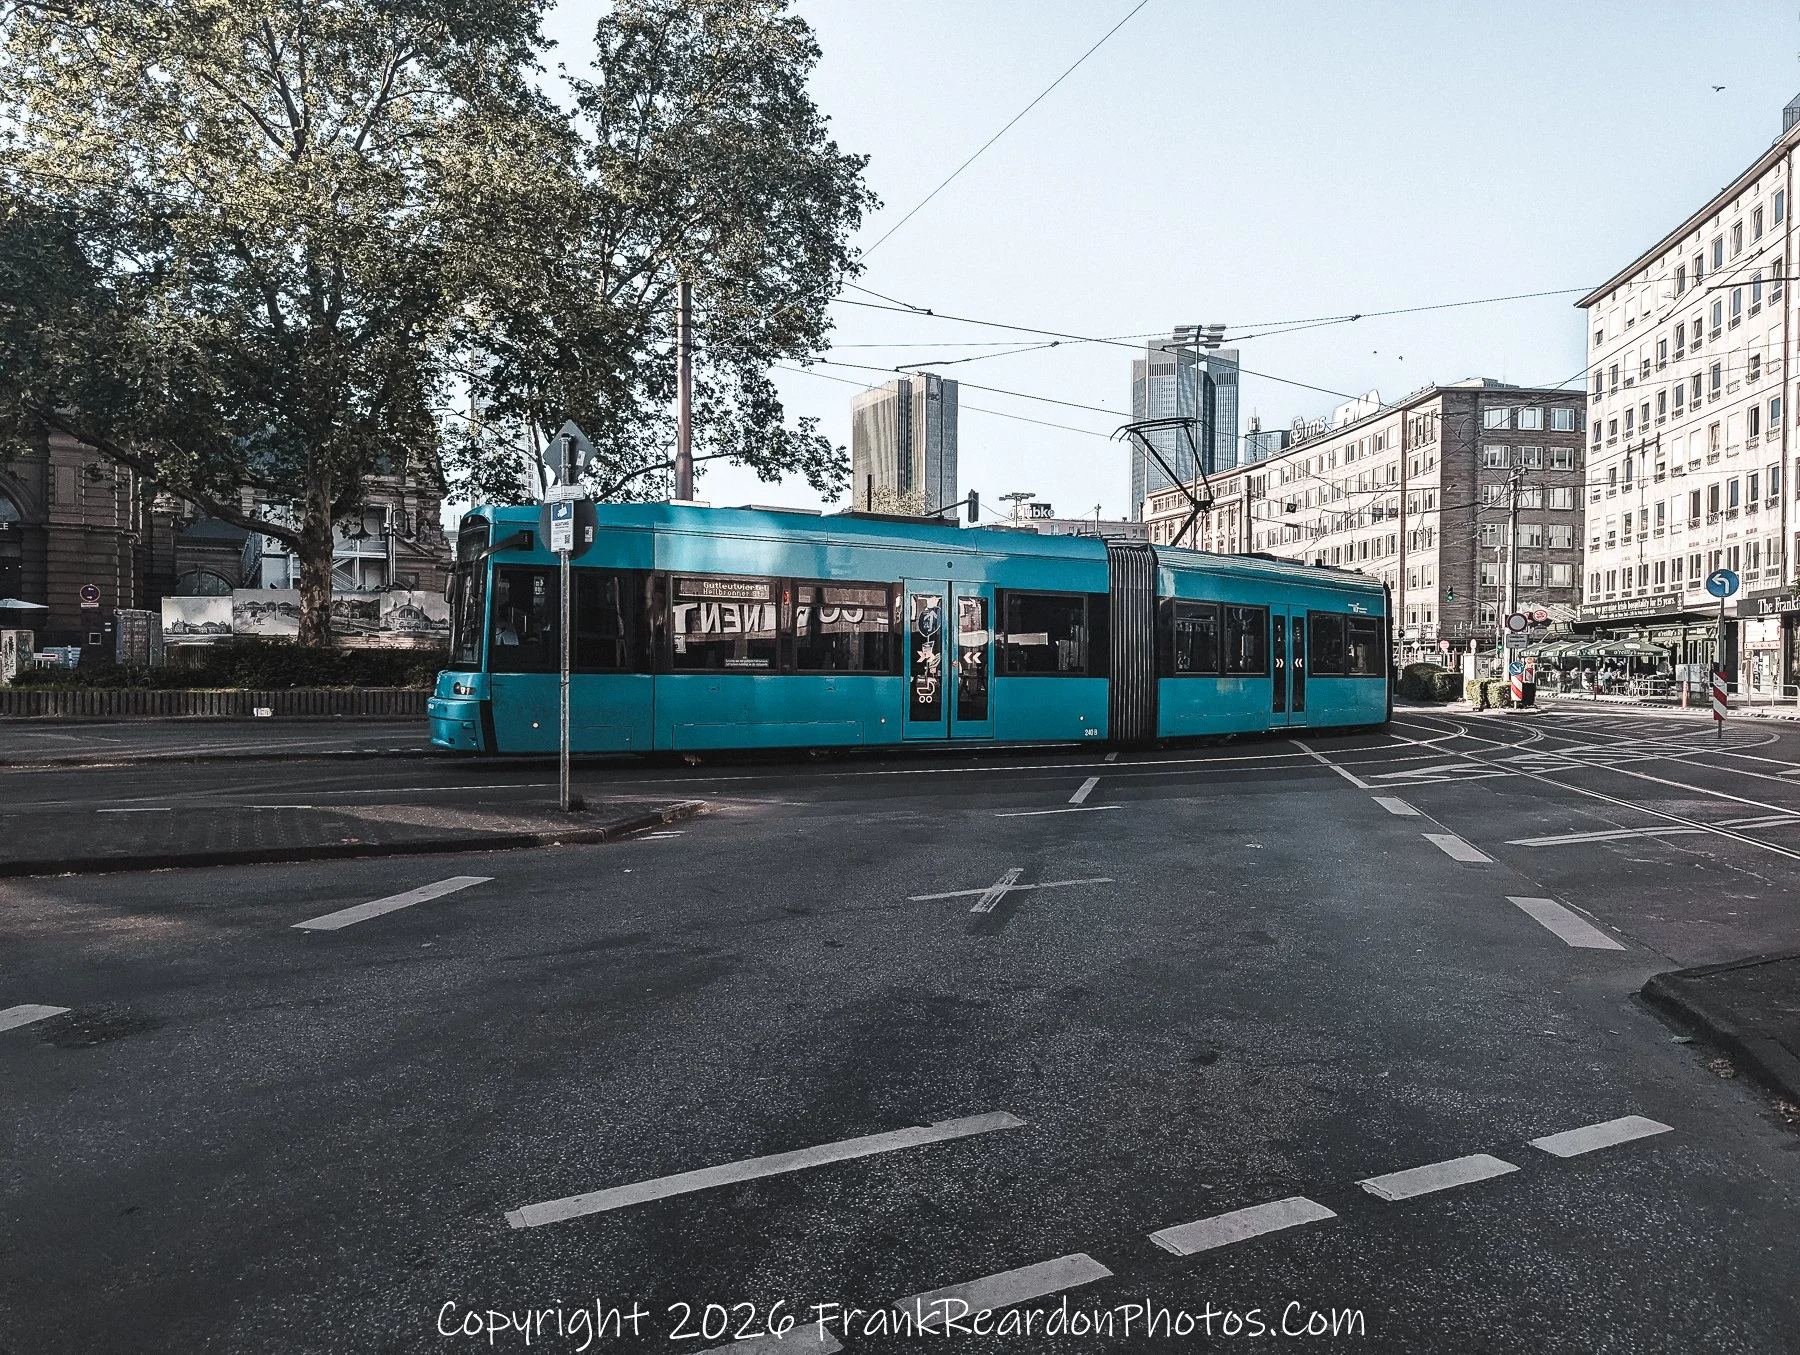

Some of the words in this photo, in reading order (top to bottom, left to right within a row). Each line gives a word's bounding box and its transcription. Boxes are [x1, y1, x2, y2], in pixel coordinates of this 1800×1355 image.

[1617, 601, 1627, 610] Irish
[1627, 599, 1649, 610] hospitality
[1758, 598, 1773, 614] The
